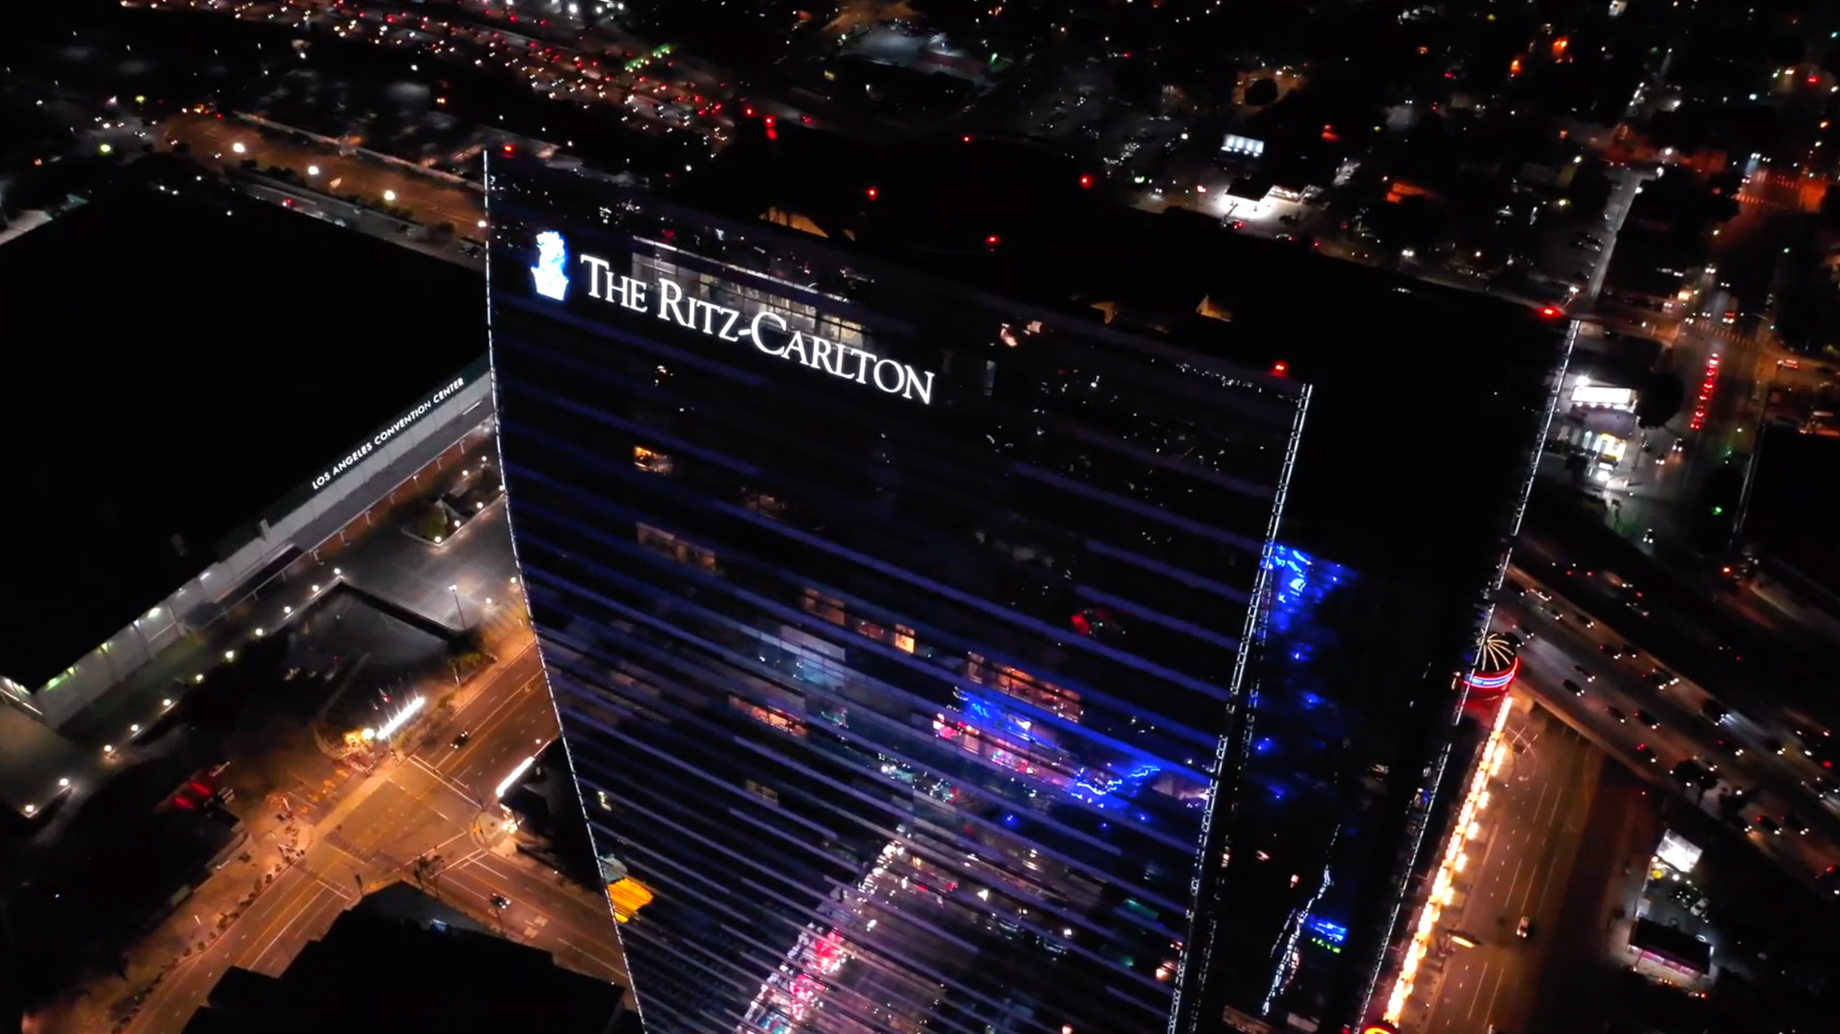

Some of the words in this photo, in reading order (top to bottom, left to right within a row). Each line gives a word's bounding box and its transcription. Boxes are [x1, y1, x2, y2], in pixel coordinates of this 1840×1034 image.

[580, 254, 647, 312] THE
[657, 278, 935, 404] RITZ-CARLTON
[312, 472, 331, 489] LOS
[332, 442, 373, 475] ANGELES
[374, 401, 431, 445] CONVENTION
[433, 377, 464, 403] CENTER
